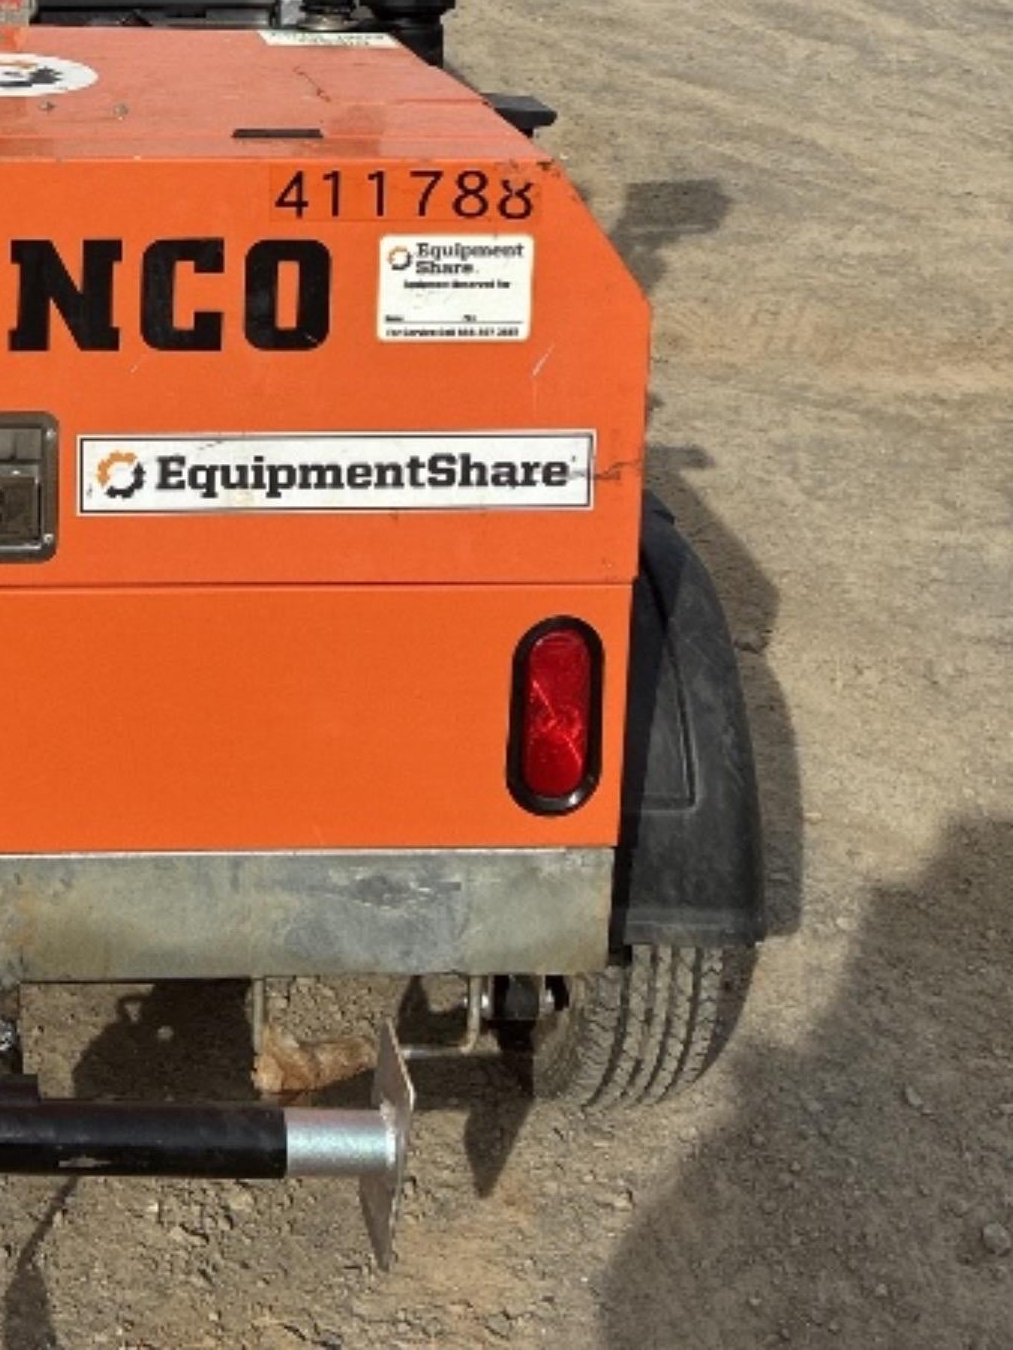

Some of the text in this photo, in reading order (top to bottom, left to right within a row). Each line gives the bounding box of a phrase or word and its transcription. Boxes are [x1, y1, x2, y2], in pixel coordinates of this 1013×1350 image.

[274, 170, 534, 220] 411788
[416, 242, 525, 262] Equipment
[155, 453, 570, 499] EquipmentShare
